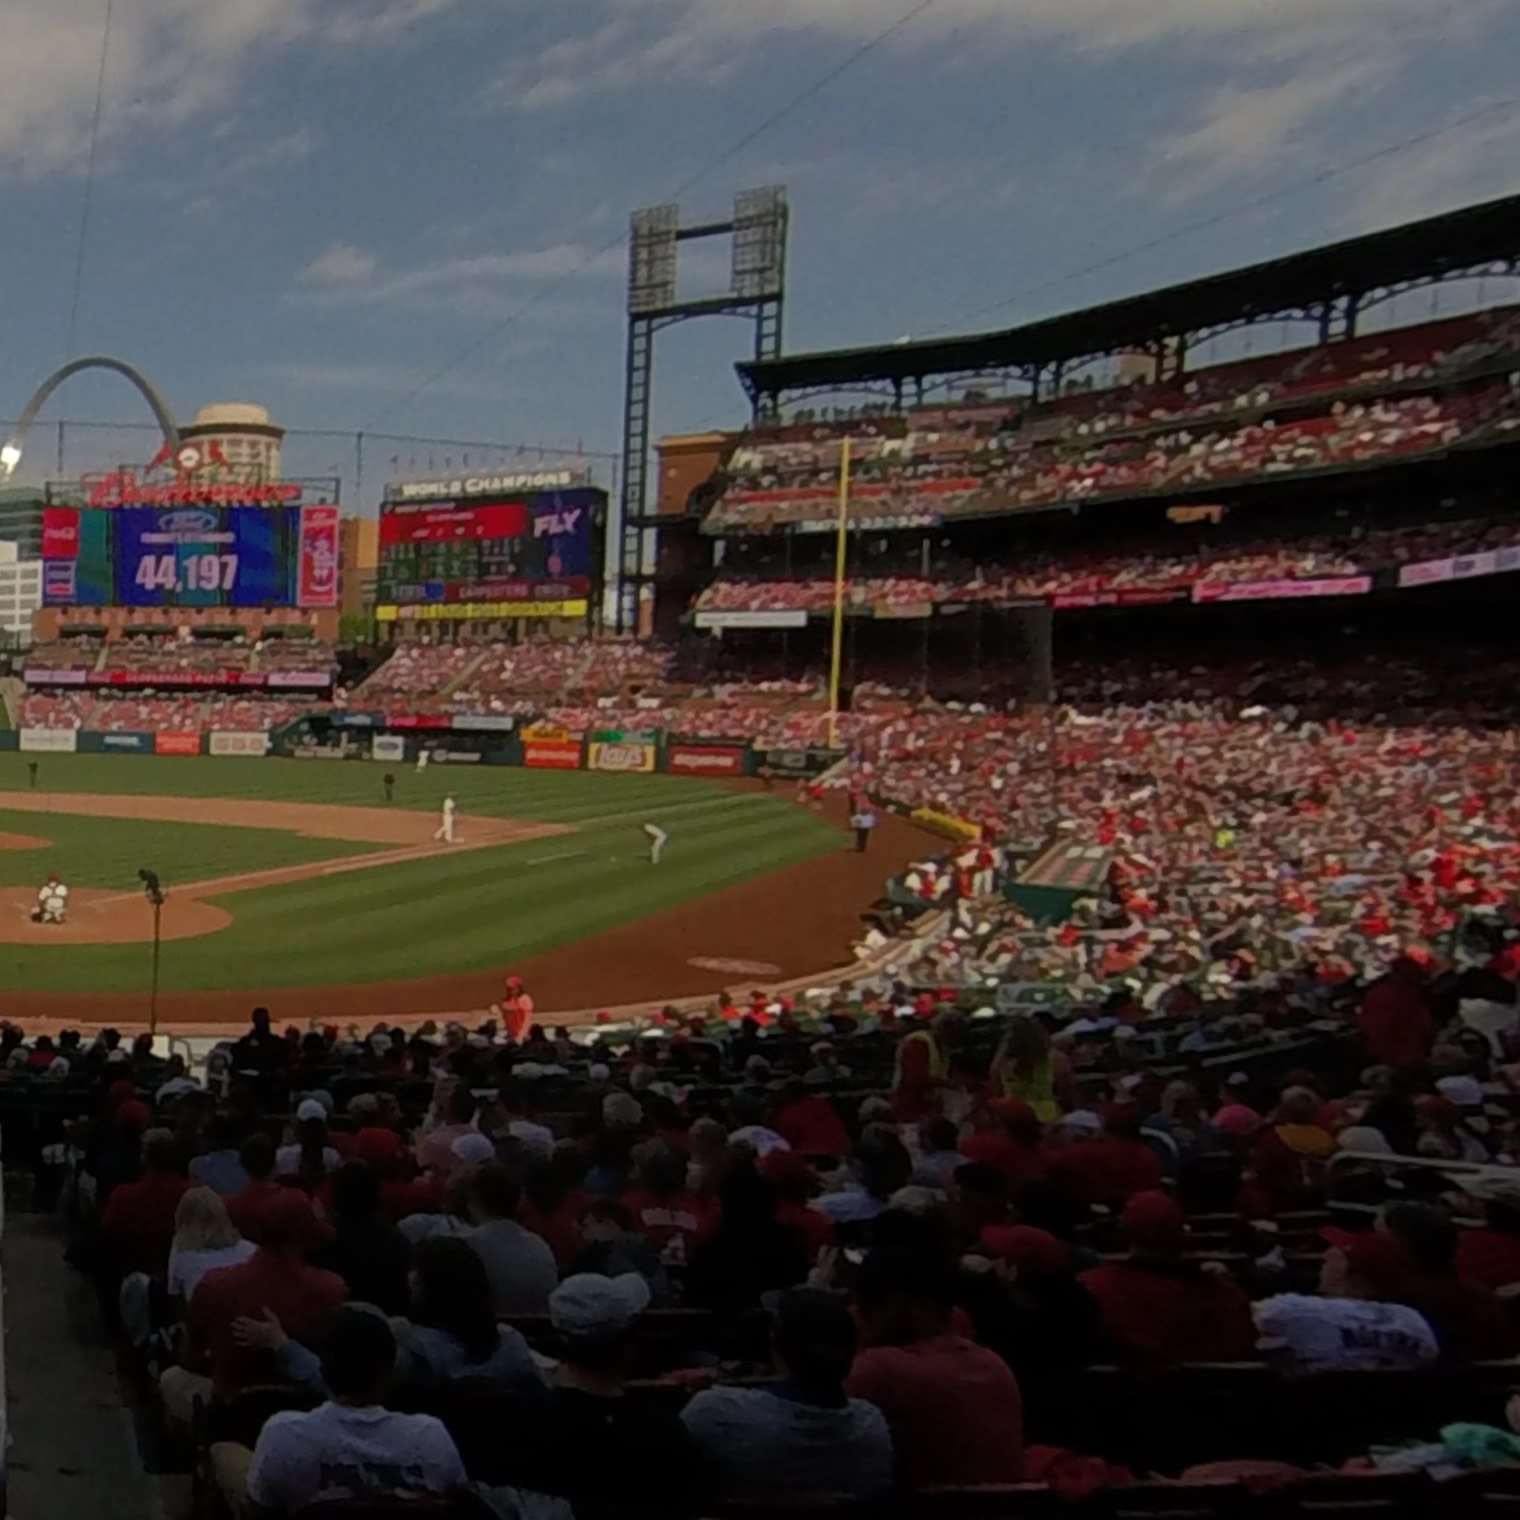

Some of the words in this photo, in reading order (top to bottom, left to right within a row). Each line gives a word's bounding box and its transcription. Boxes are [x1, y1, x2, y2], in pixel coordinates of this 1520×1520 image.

[401, 481, 462, 496] WORLD
[465, 472, 571, 493] CHAMPIONS
[533, 508, 582, 538] FLY
[135, 554, 238, 592] 44,197
